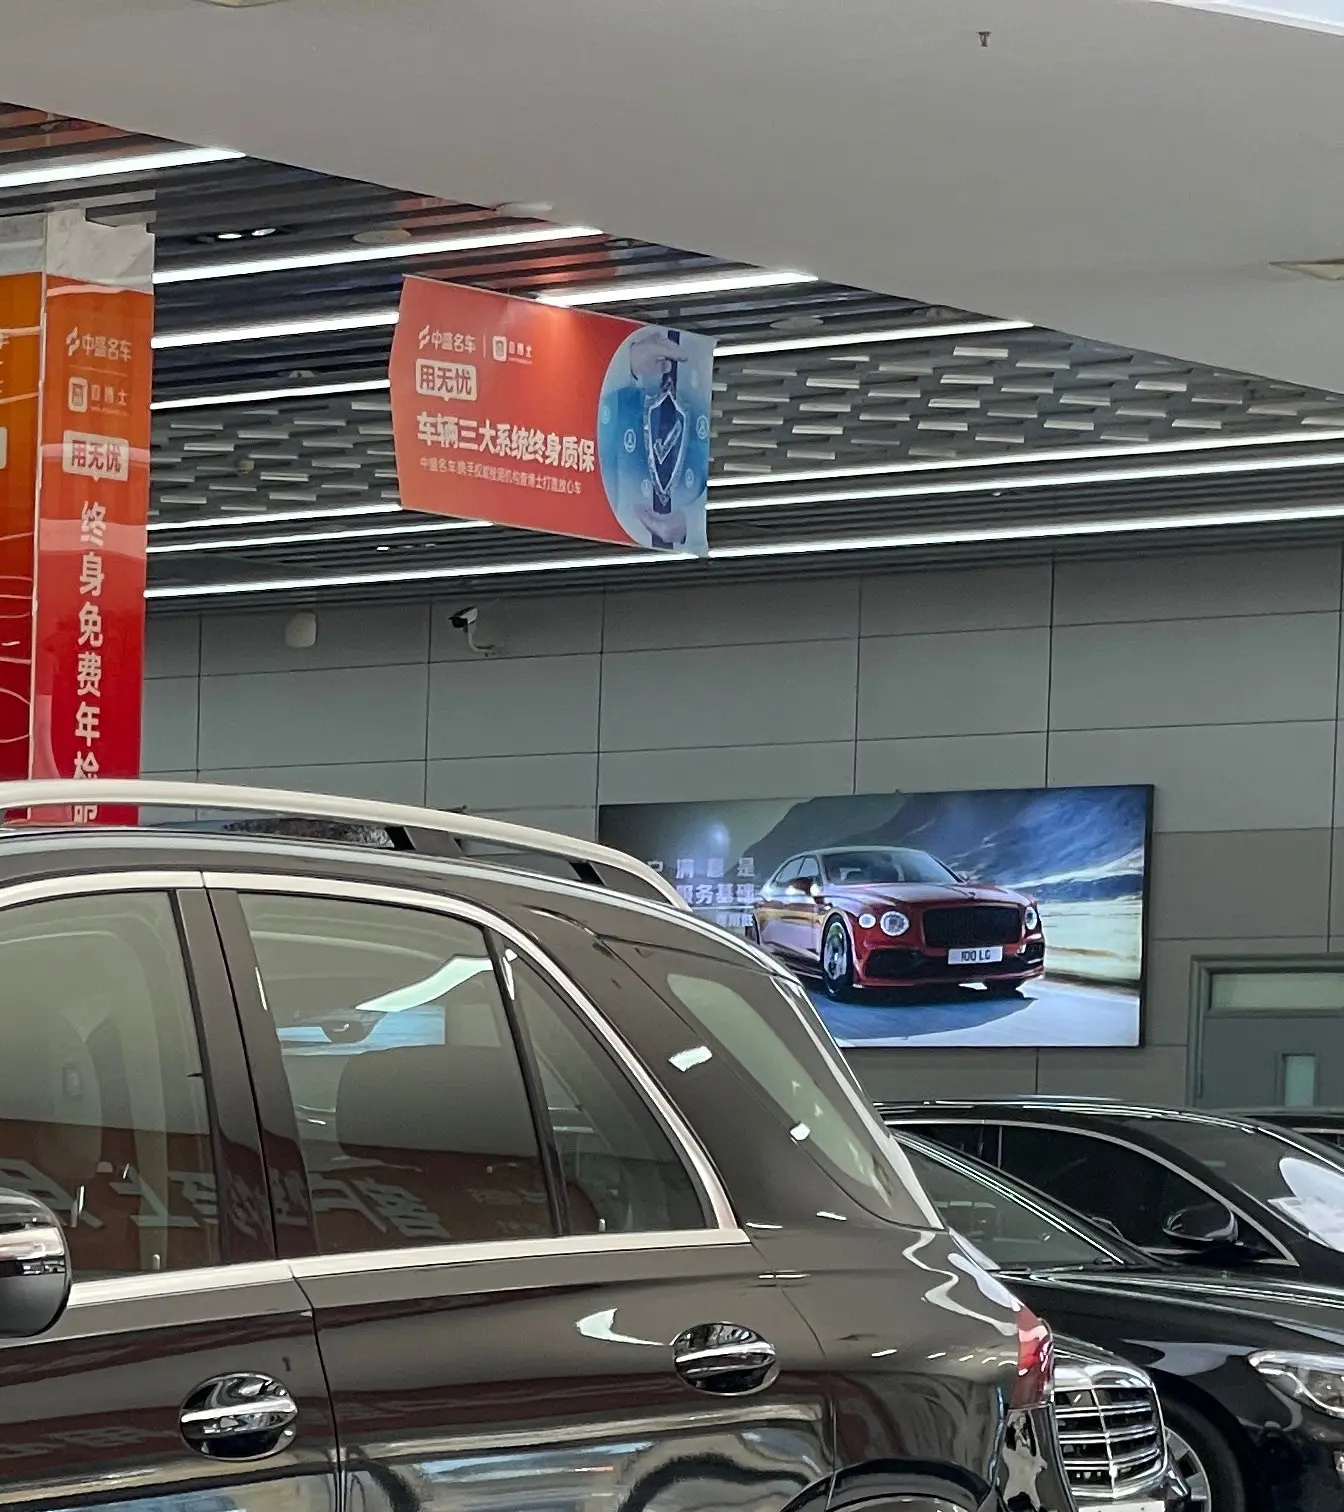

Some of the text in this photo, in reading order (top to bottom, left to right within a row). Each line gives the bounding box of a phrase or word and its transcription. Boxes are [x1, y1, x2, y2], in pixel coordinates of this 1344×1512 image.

[81, 334, 132, 363] 中盛名车
[431, 330, 476, 354] 中盛名车
[420, 365, 472, 395] 用无忧
[71, 439, 122, 473] 用无忧
[417, 411, 595, 473] 车辆三大系统终身质保
